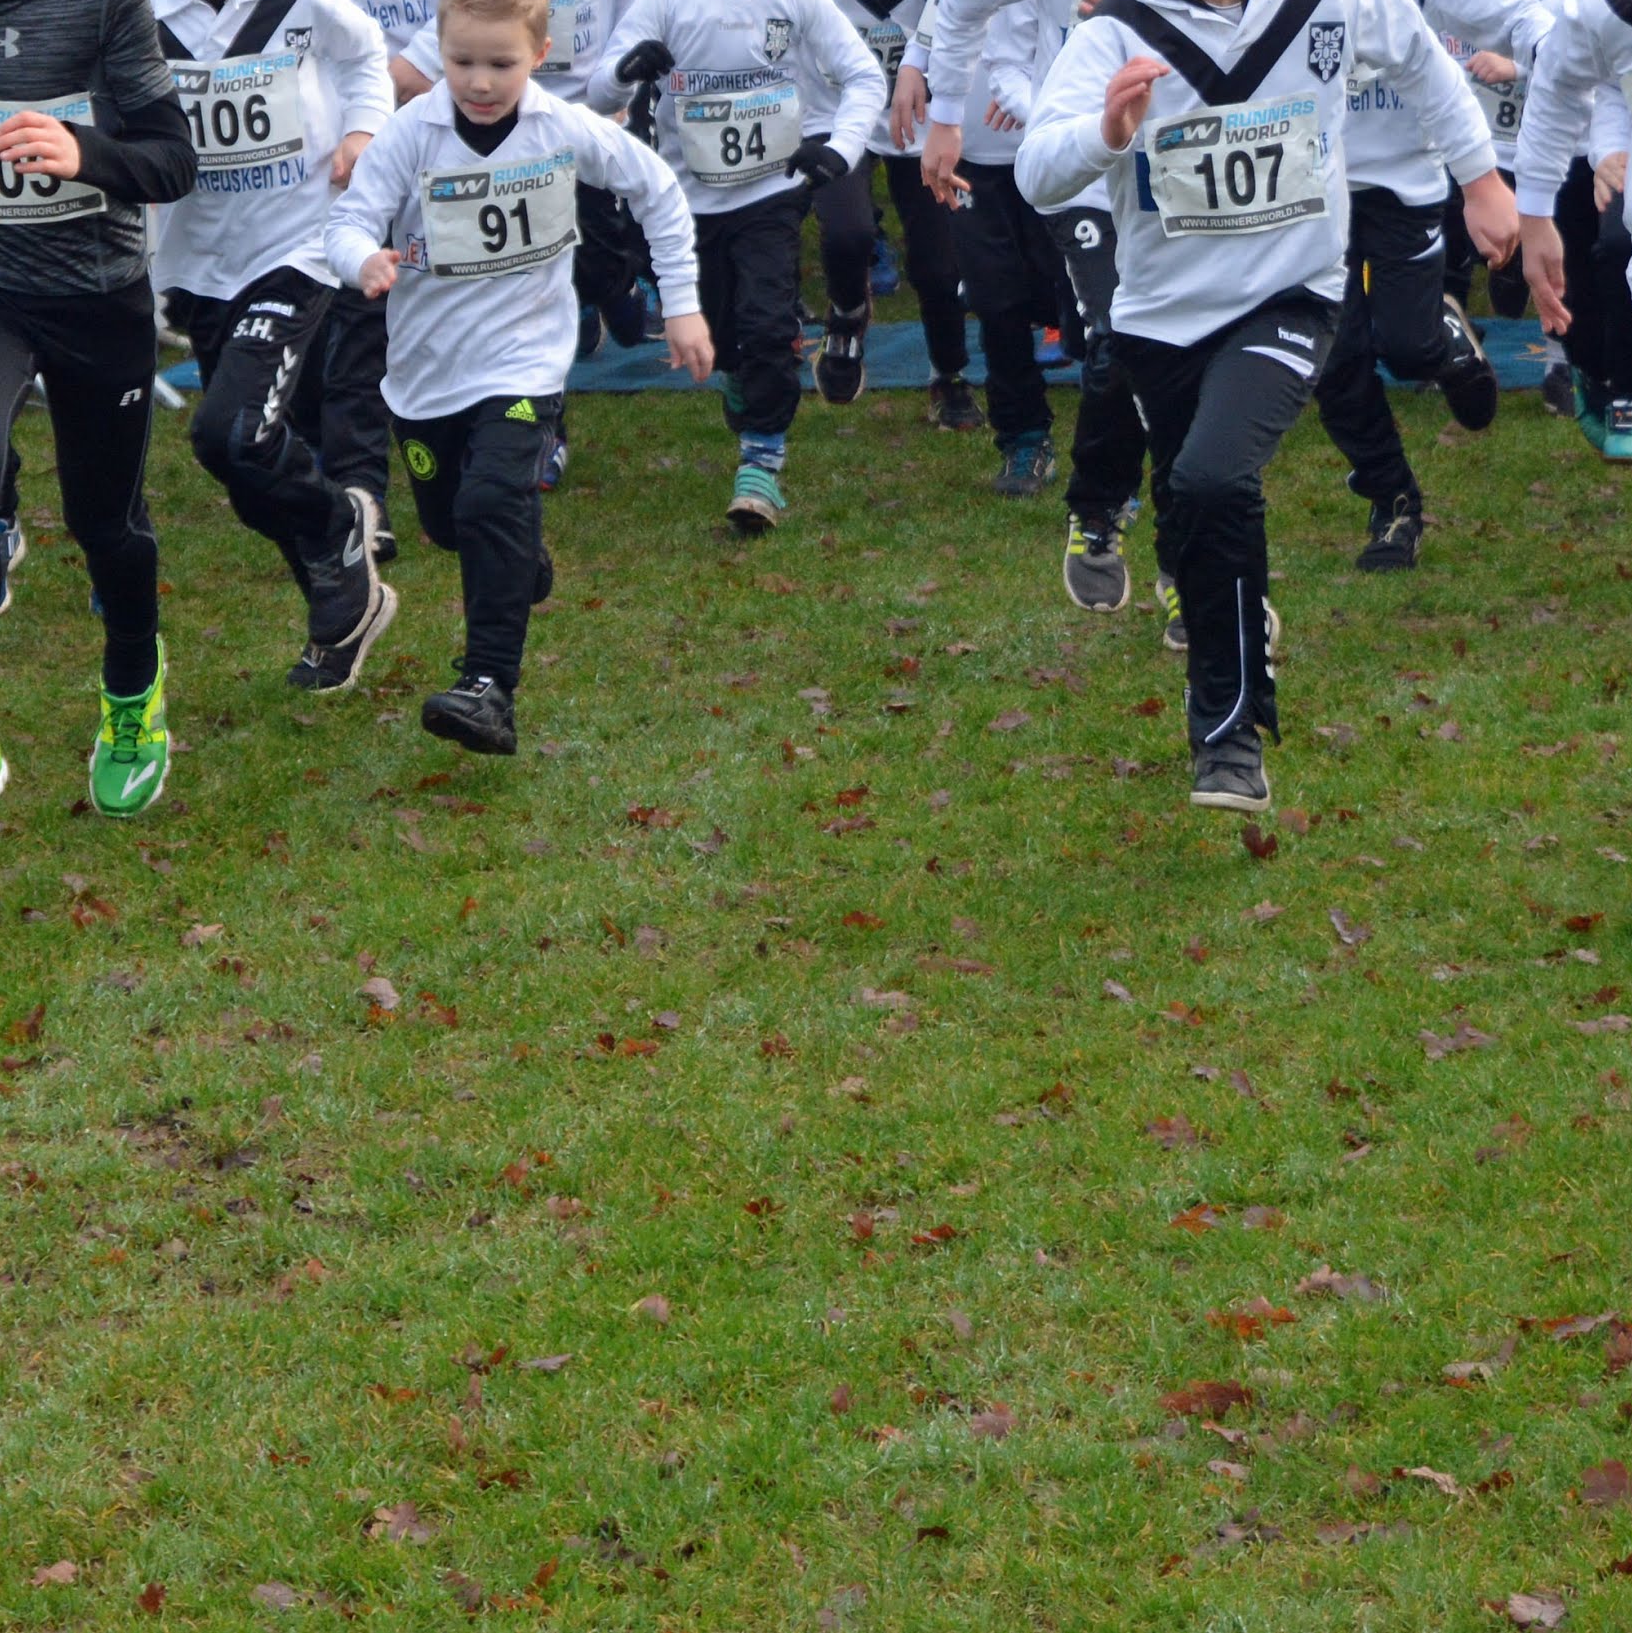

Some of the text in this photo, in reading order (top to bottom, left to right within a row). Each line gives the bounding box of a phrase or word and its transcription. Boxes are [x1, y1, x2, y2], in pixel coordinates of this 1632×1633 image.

[214, 54, 297, 81] RUNNERS
[671, 70, 685, 92] DE
[213, 74, 273, 94] WORLD
[1375, 80, 1404, 110] b.v.
[733, 87, 795, 110] RUNNERS
[733, 103, 781, 121] WORLD
[186, 94, 271, 148] 106
[1225, 100, 1315, 129] RUNNERS
[1496, 101, 1523, 129] 8
[720, 122, 766, 167] 84
[1225, 120, 1290, 145] WORLD
[197, 145, 289, 164] .RUNNERSWORLD.NL
[494, 151, 575, 183] RUNNERS
[493, 172, 555, 197] WORLD
[1194, 142, 1284, 210] 107
[478, 197, 532, 254] 91
[1180, 204, 1307, 229] WWW.RUNNERSWORLD.NL
[451, 241, 565, 275] WWW.RUNNERSWORLD.NL
[505, 410, 536, 422] adidas
